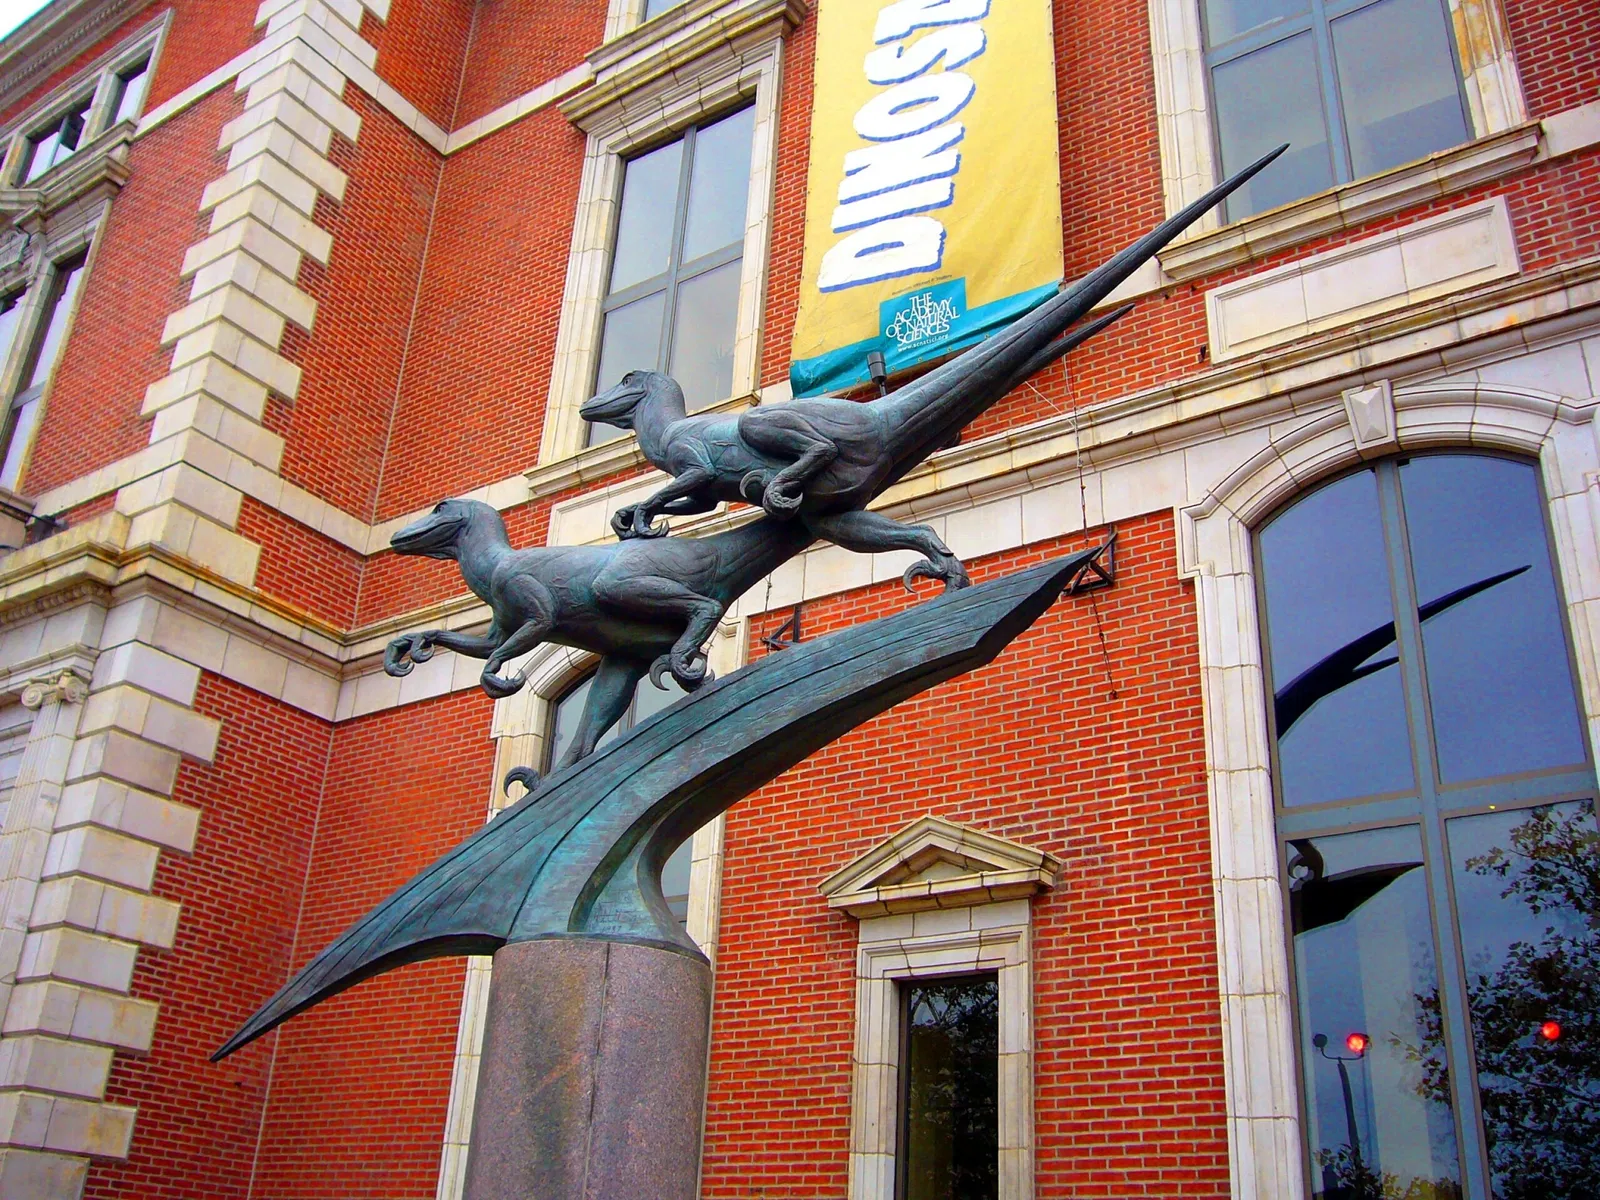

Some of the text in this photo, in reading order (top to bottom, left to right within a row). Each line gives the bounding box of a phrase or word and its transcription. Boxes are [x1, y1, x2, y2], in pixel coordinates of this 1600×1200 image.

[894, 297, 952, 323] ACADEMY
[909, 292, 932, 308] THE
[885, 306, 960, 338] OF NATURAL
[897, 320, 950, 347] SCIENCES
